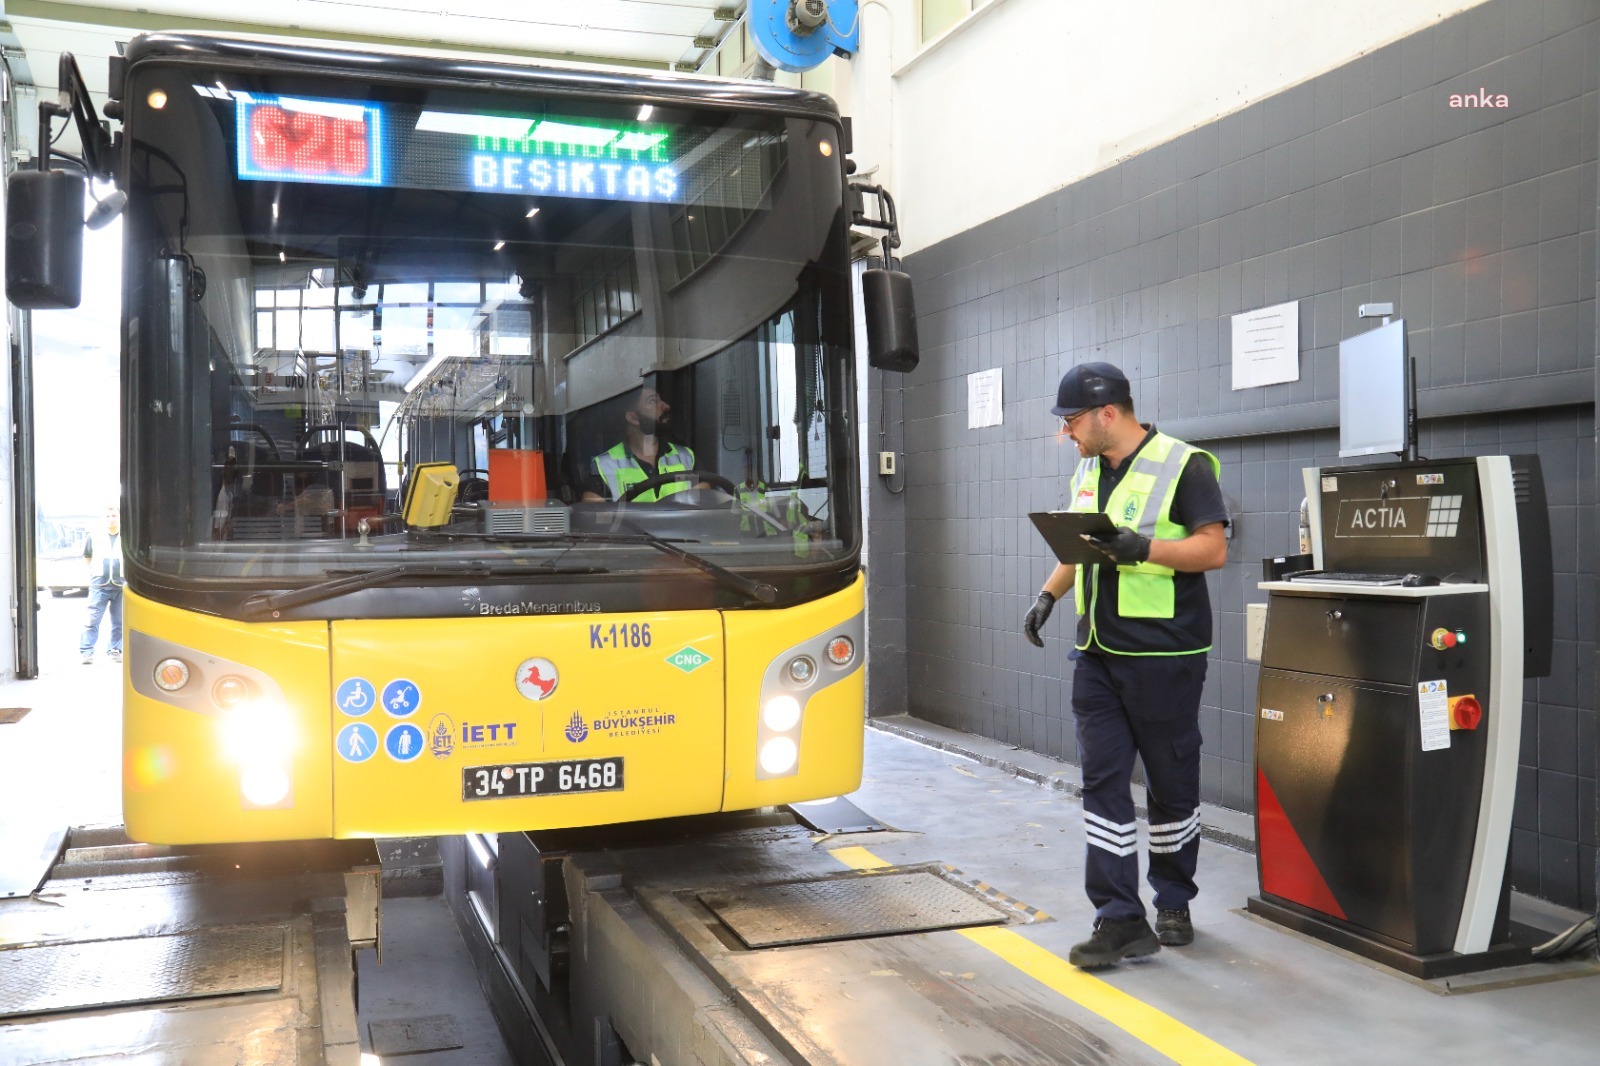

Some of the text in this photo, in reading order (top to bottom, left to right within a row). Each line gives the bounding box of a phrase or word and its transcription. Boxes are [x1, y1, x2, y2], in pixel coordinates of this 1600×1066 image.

[1351, 507, 1407, 529] ACTIA
[590, 623, 652, 649] K-1186
[674, 654, 702, 666] CNG
[593, 712, 676, 731] BÜYÜKŞEHİR
[462, 722, 517, 743] İETT
[475, 762, 617, 796] 34 TP 6468
